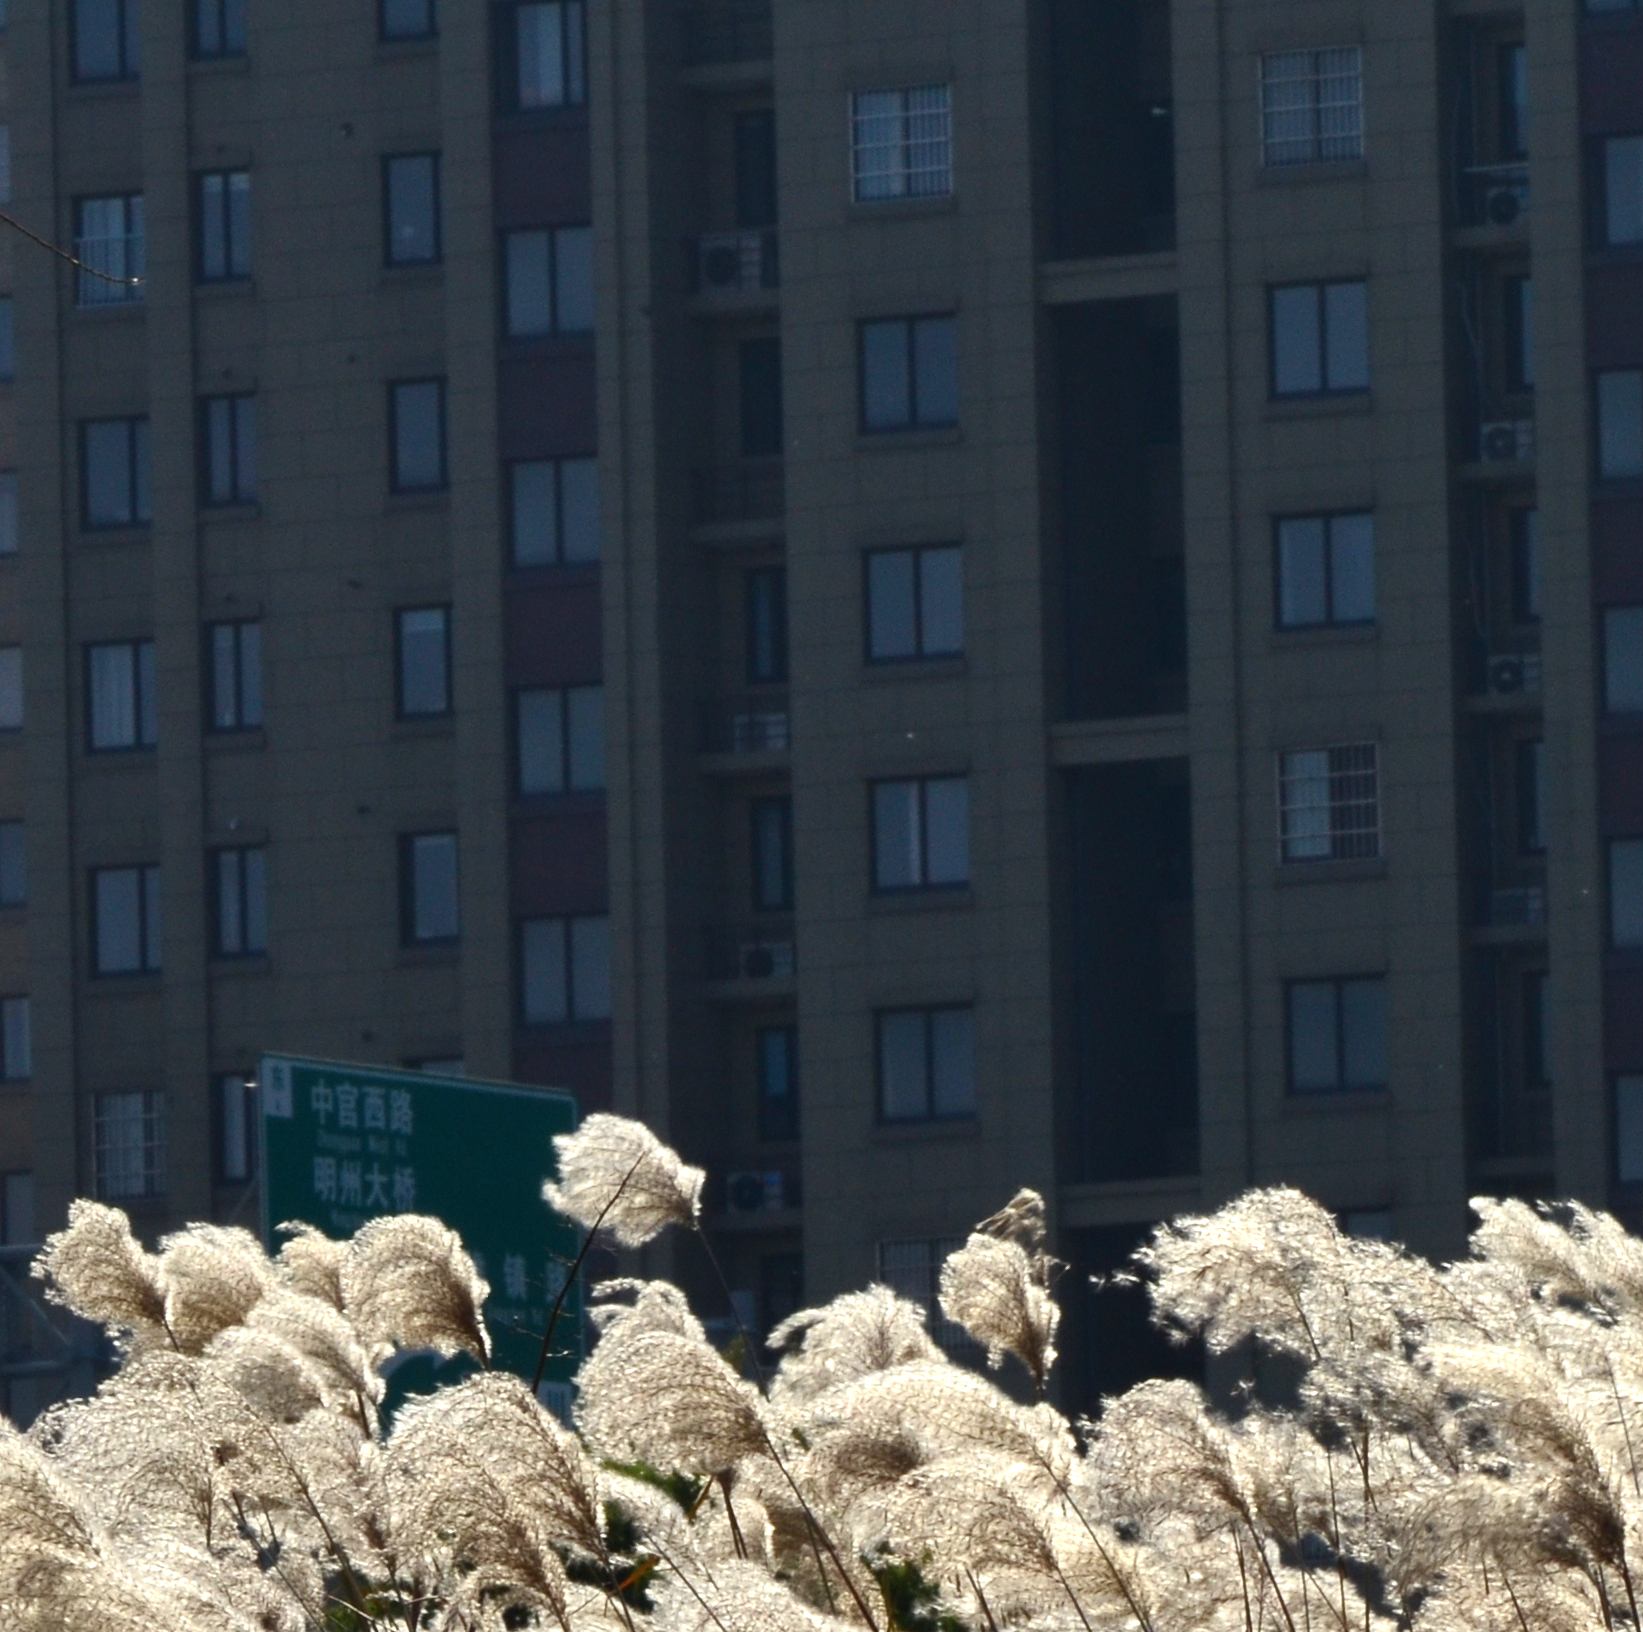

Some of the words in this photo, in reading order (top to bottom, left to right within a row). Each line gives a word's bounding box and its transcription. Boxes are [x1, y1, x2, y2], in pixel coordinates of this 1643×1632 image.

[312, 1078, 412, 1136] 中官西路
[313, 1156, 415, 1211] 明州大桥
